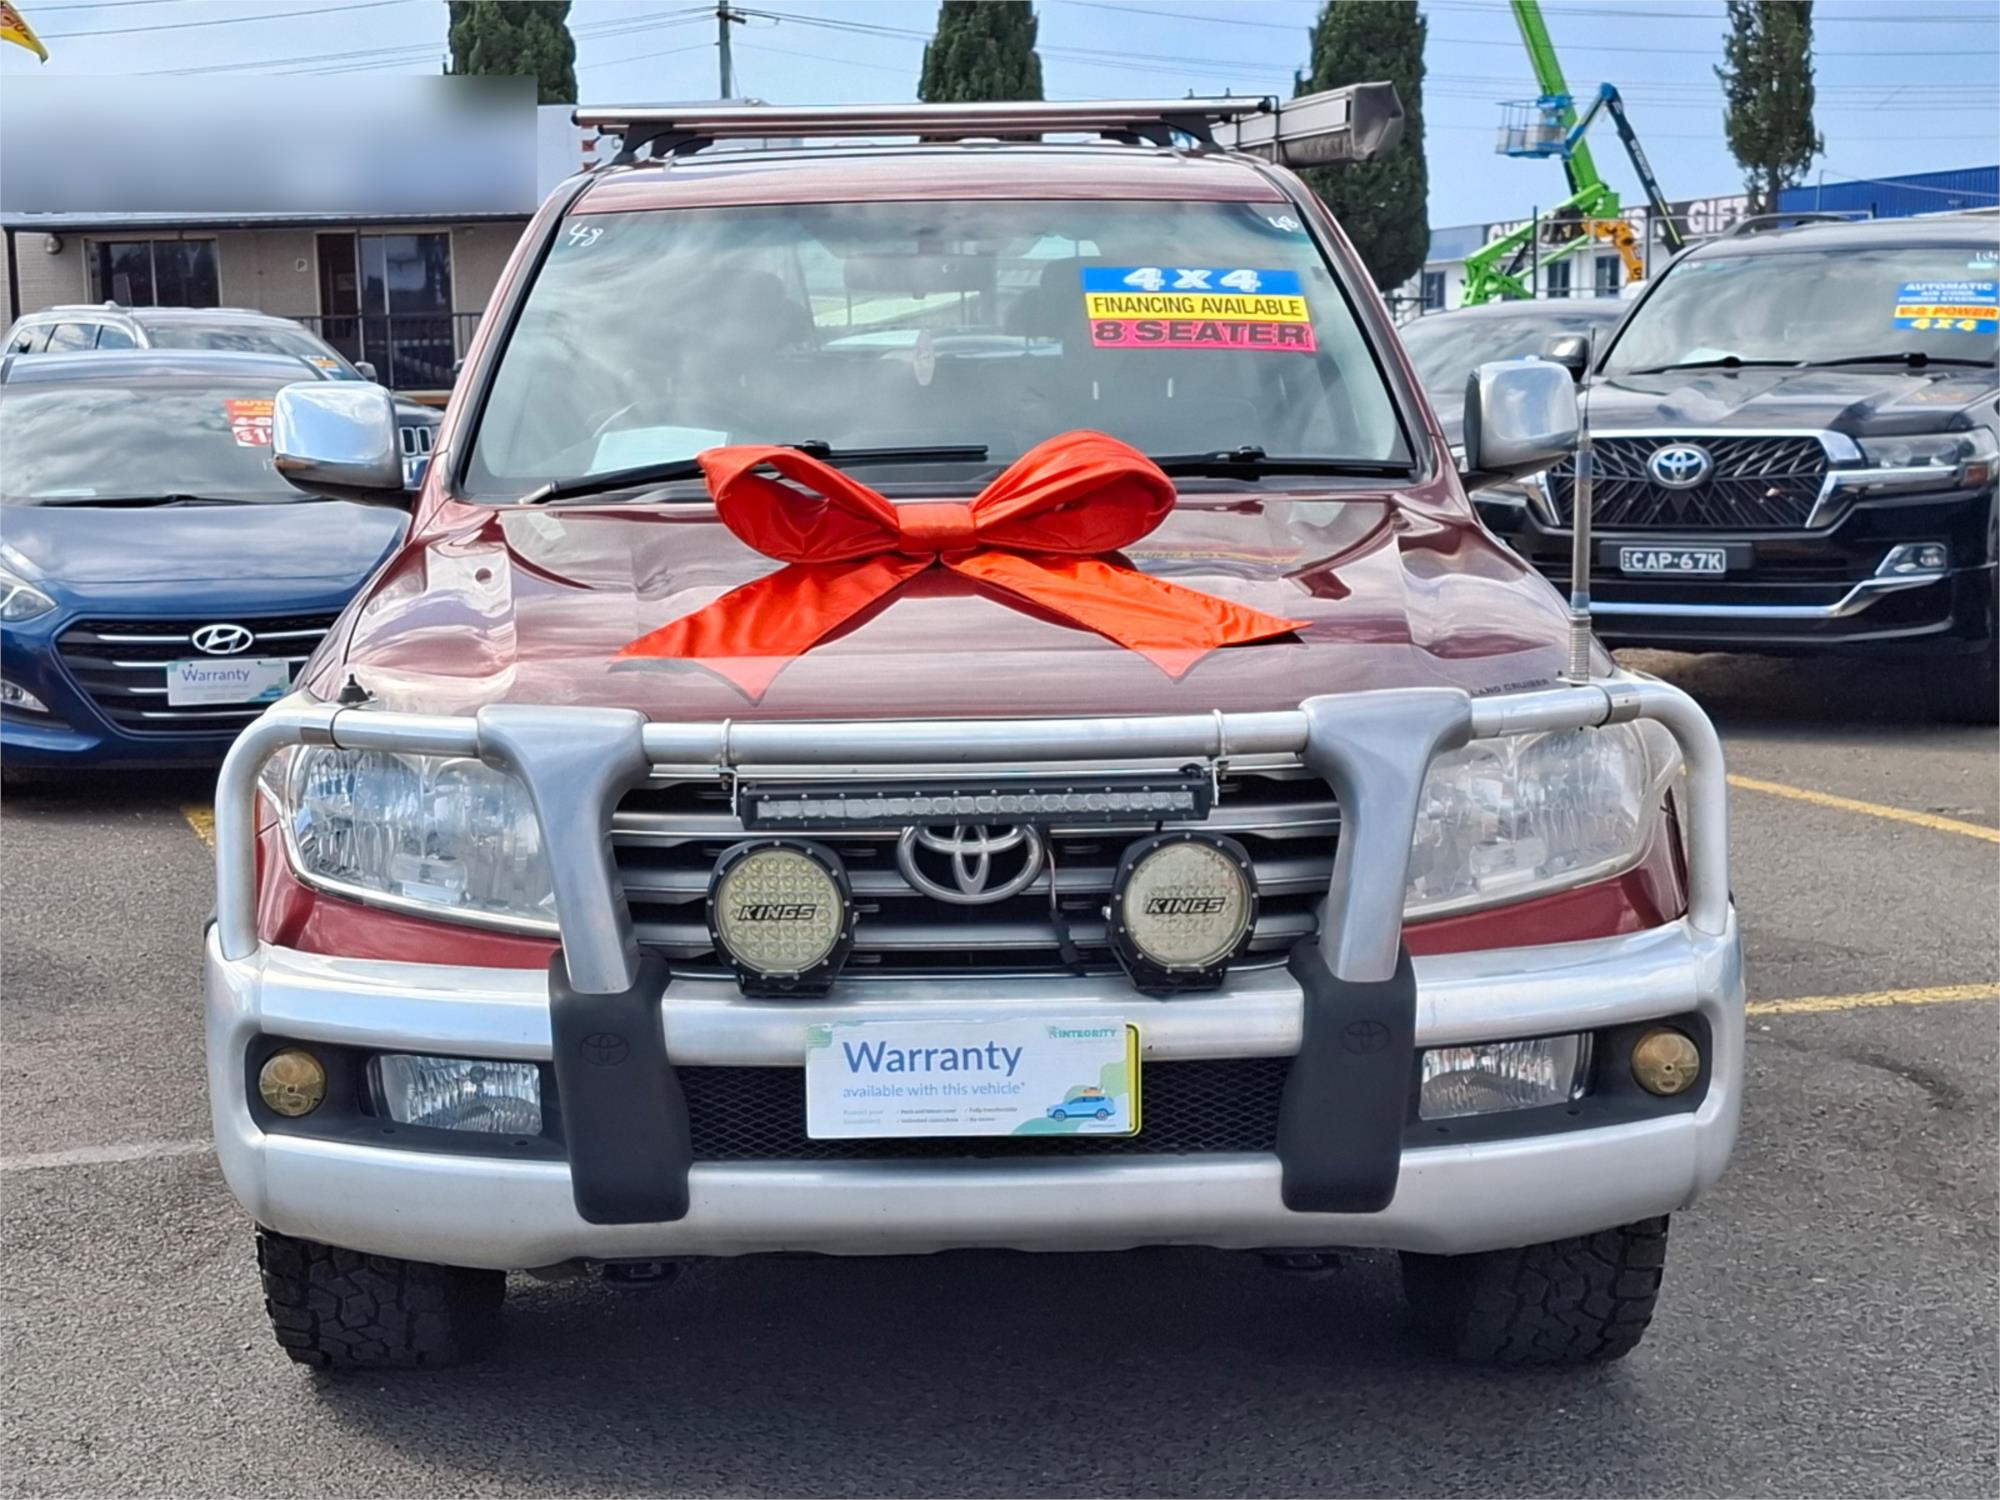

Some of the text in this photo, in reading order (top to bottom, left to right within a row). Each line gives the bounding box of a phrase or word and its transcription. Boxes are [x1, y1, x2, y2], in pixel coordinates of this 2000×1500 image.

[1904, 282, 1993, 291] AUTOMATIC
[1094, 296, 1302, 316] FINANCING AVAILABLE
[1932, 307, 1998, 317] POWER
[1094, 321, 1310, 345] 8 SEATER
[182, 668, 250, 682] Warranty
[738, 904, 817, 921] KINGS
[1145, 897, 1227, 914] KINGS
[843, 1040, 1023, 1077] Warranty
[843, 1084, 904, 1098] available
[907, 1083, 938, 1097] with
[942, 1081, 968, 1096] this
